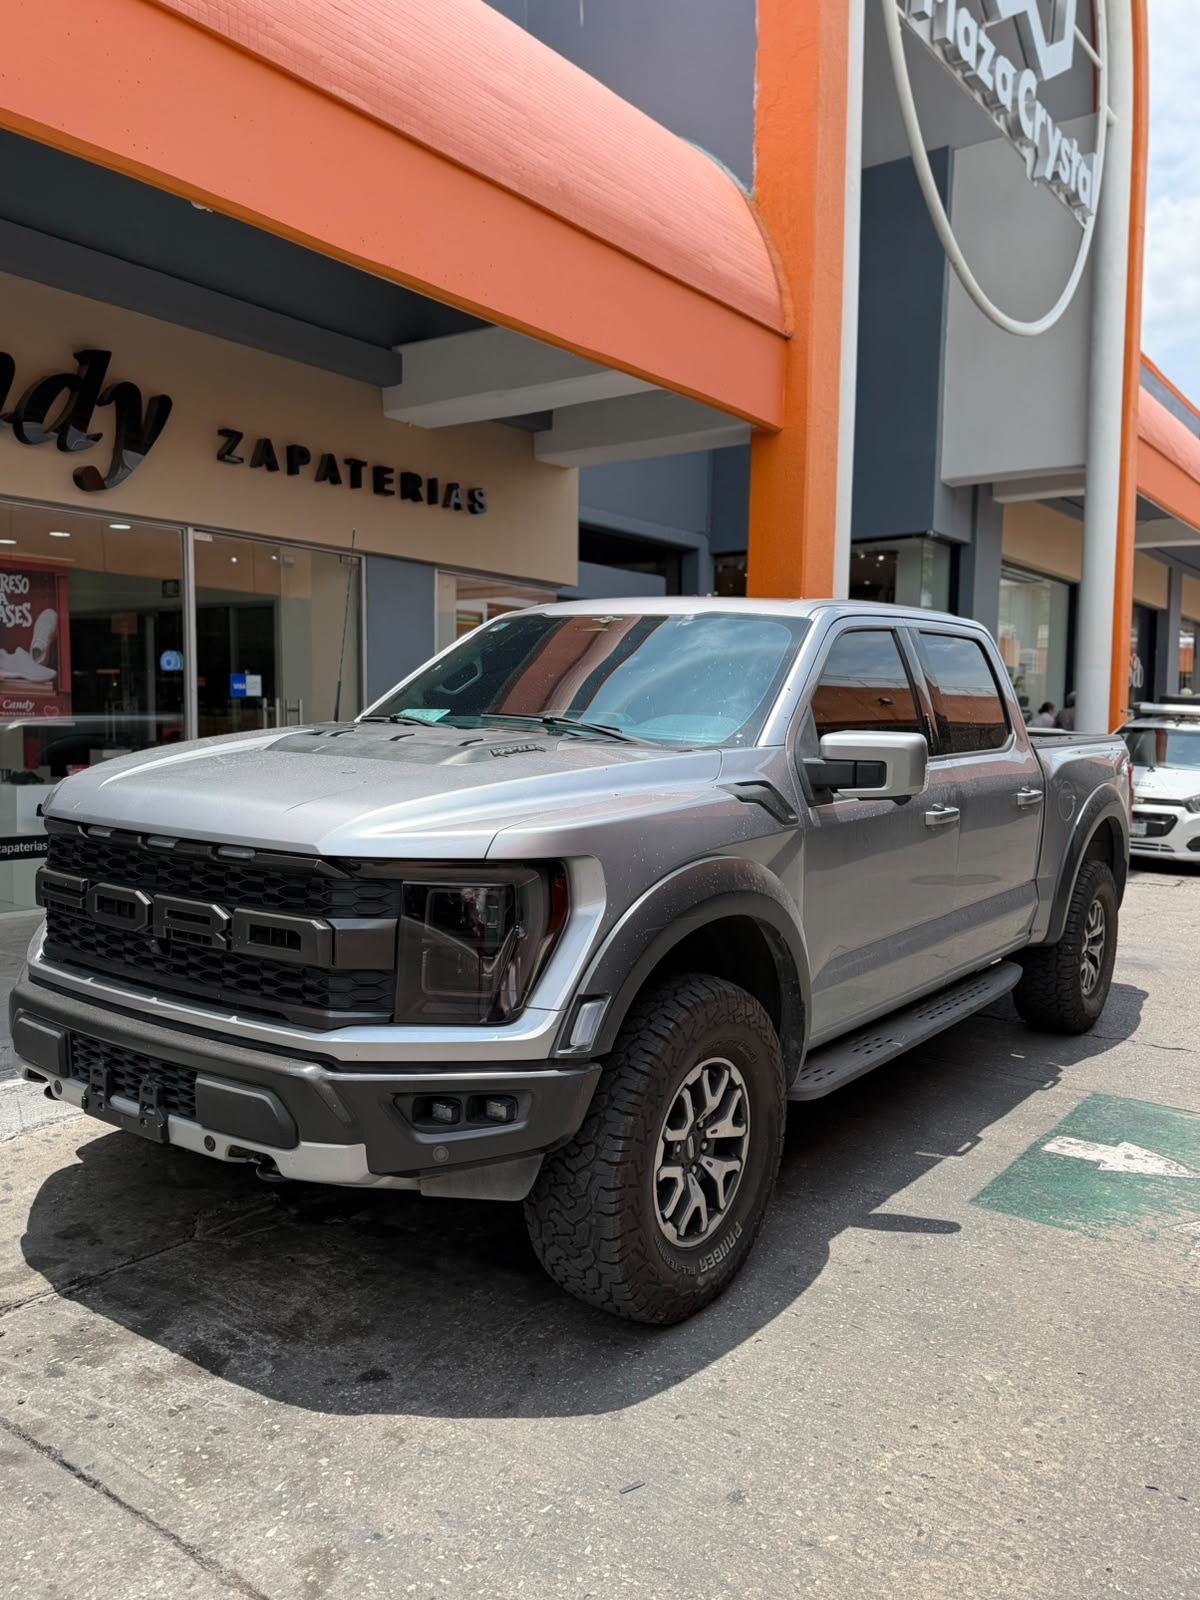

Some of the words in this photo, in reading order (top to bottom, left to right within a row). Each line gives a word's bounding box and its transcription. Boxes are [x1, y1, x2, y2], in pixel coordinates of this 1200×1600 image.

[0, 350, 173, 492] dy
[217, 429, 488, 514] ZAPATERIAS
[2, 699, 36, 712] Candy
[0, 840, 48, 855] apaterias
[35, 866, 334, 969] FORD
